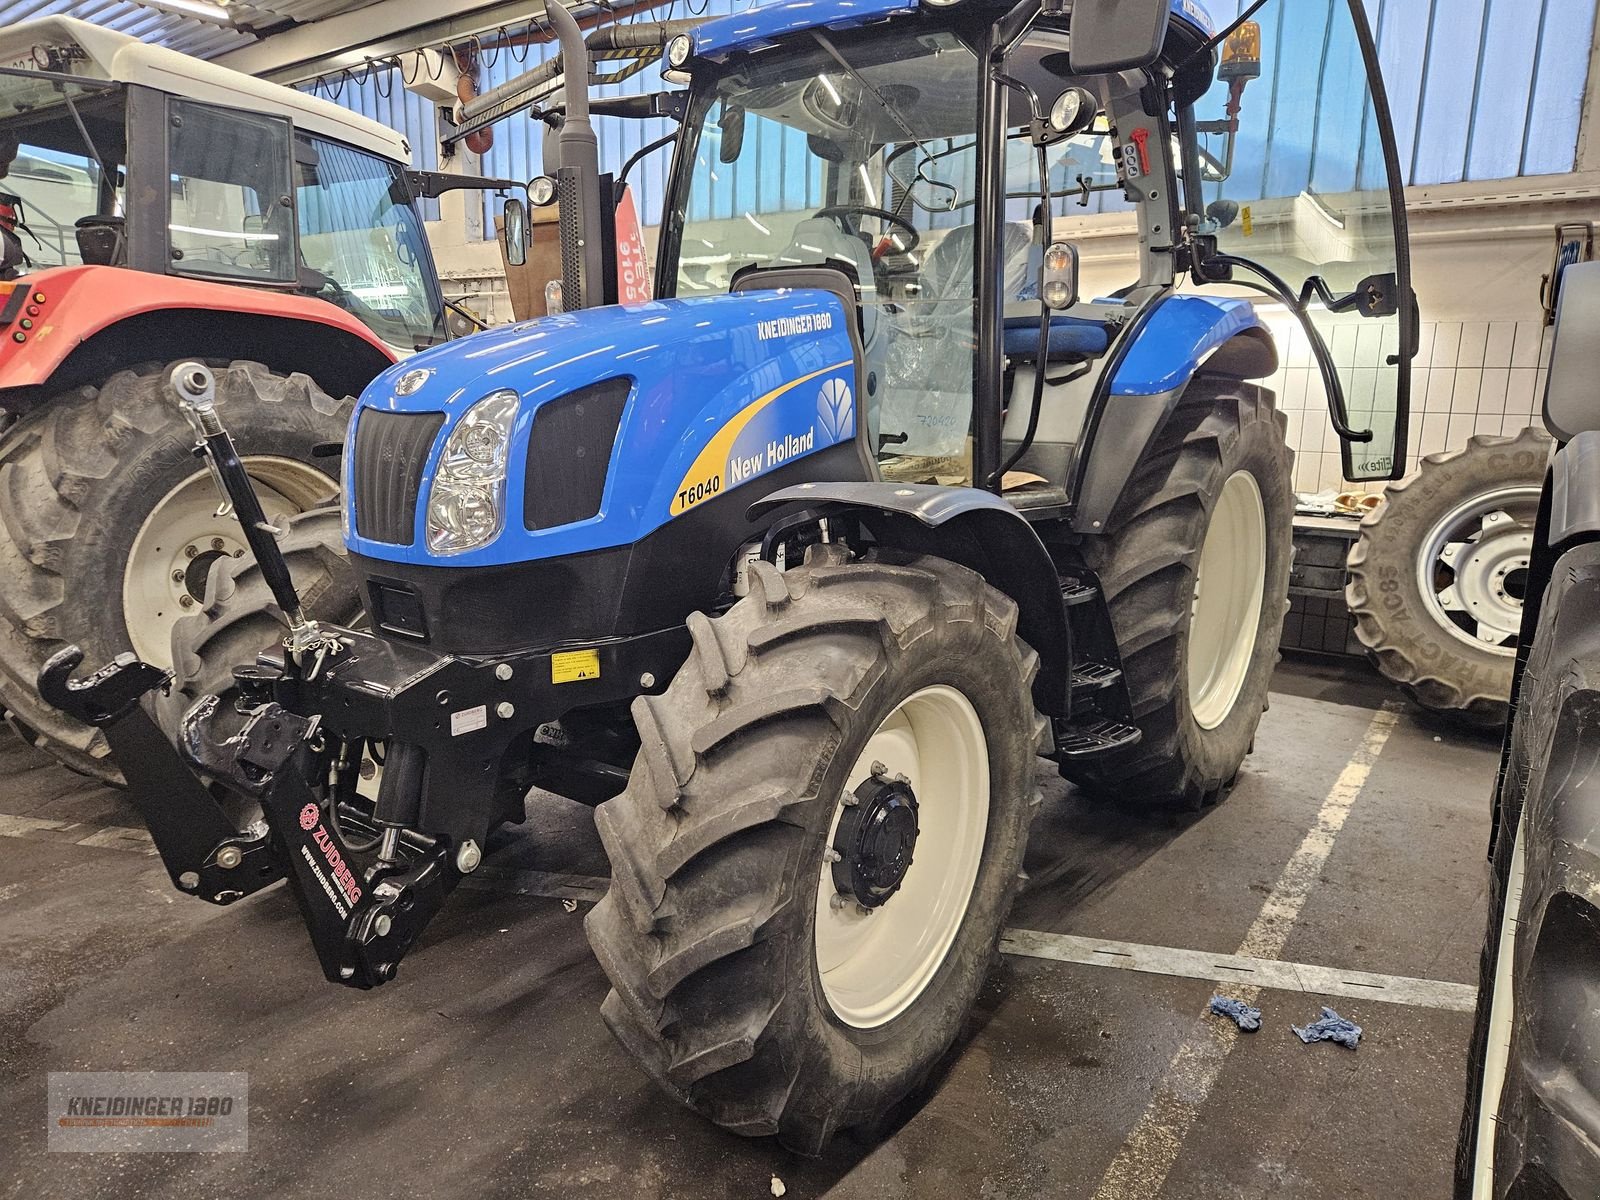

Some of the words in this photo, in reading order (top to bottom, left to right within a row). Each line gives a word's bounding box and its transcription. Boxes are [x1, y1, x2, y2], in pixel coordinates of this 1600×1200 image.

[630, 231, 650, 302] STEY
[757, 315, 813, 341] KNEIDINGER
[813, 312, 832, 332] 1880
[730, 453, 763, 484] New
[767, 426, 814, 467] Holland
[679, 475, 720, 509] T6040
[313, 824, 362, 904] ZUIDBERG
